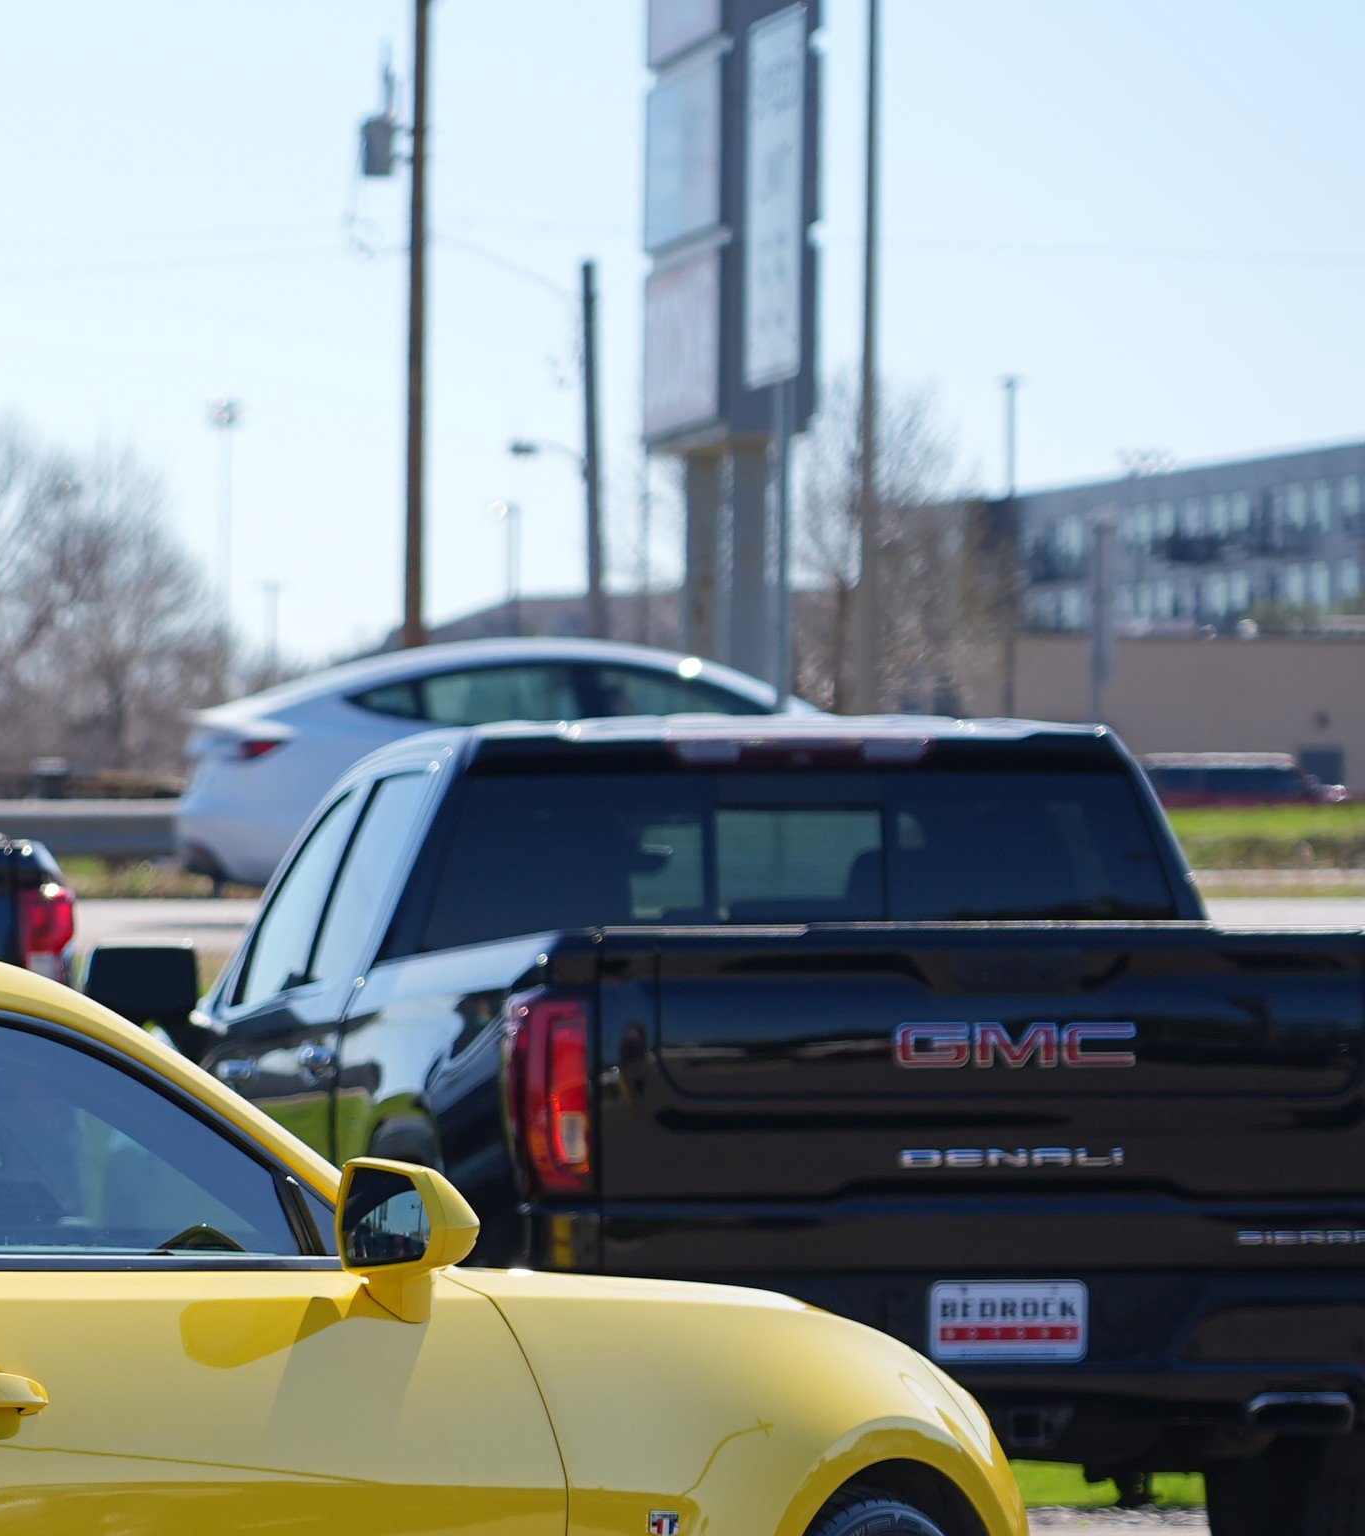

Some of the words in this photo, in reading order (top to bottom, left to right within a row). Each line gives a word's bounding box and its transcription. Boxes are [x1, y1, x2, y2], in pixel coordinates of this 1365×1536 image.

[895, 1021, 1137, 1068] GMC
[899, 1147, 1125, 1168] DENALI
[940, 1297, 1078, 1319] BEDROCK
